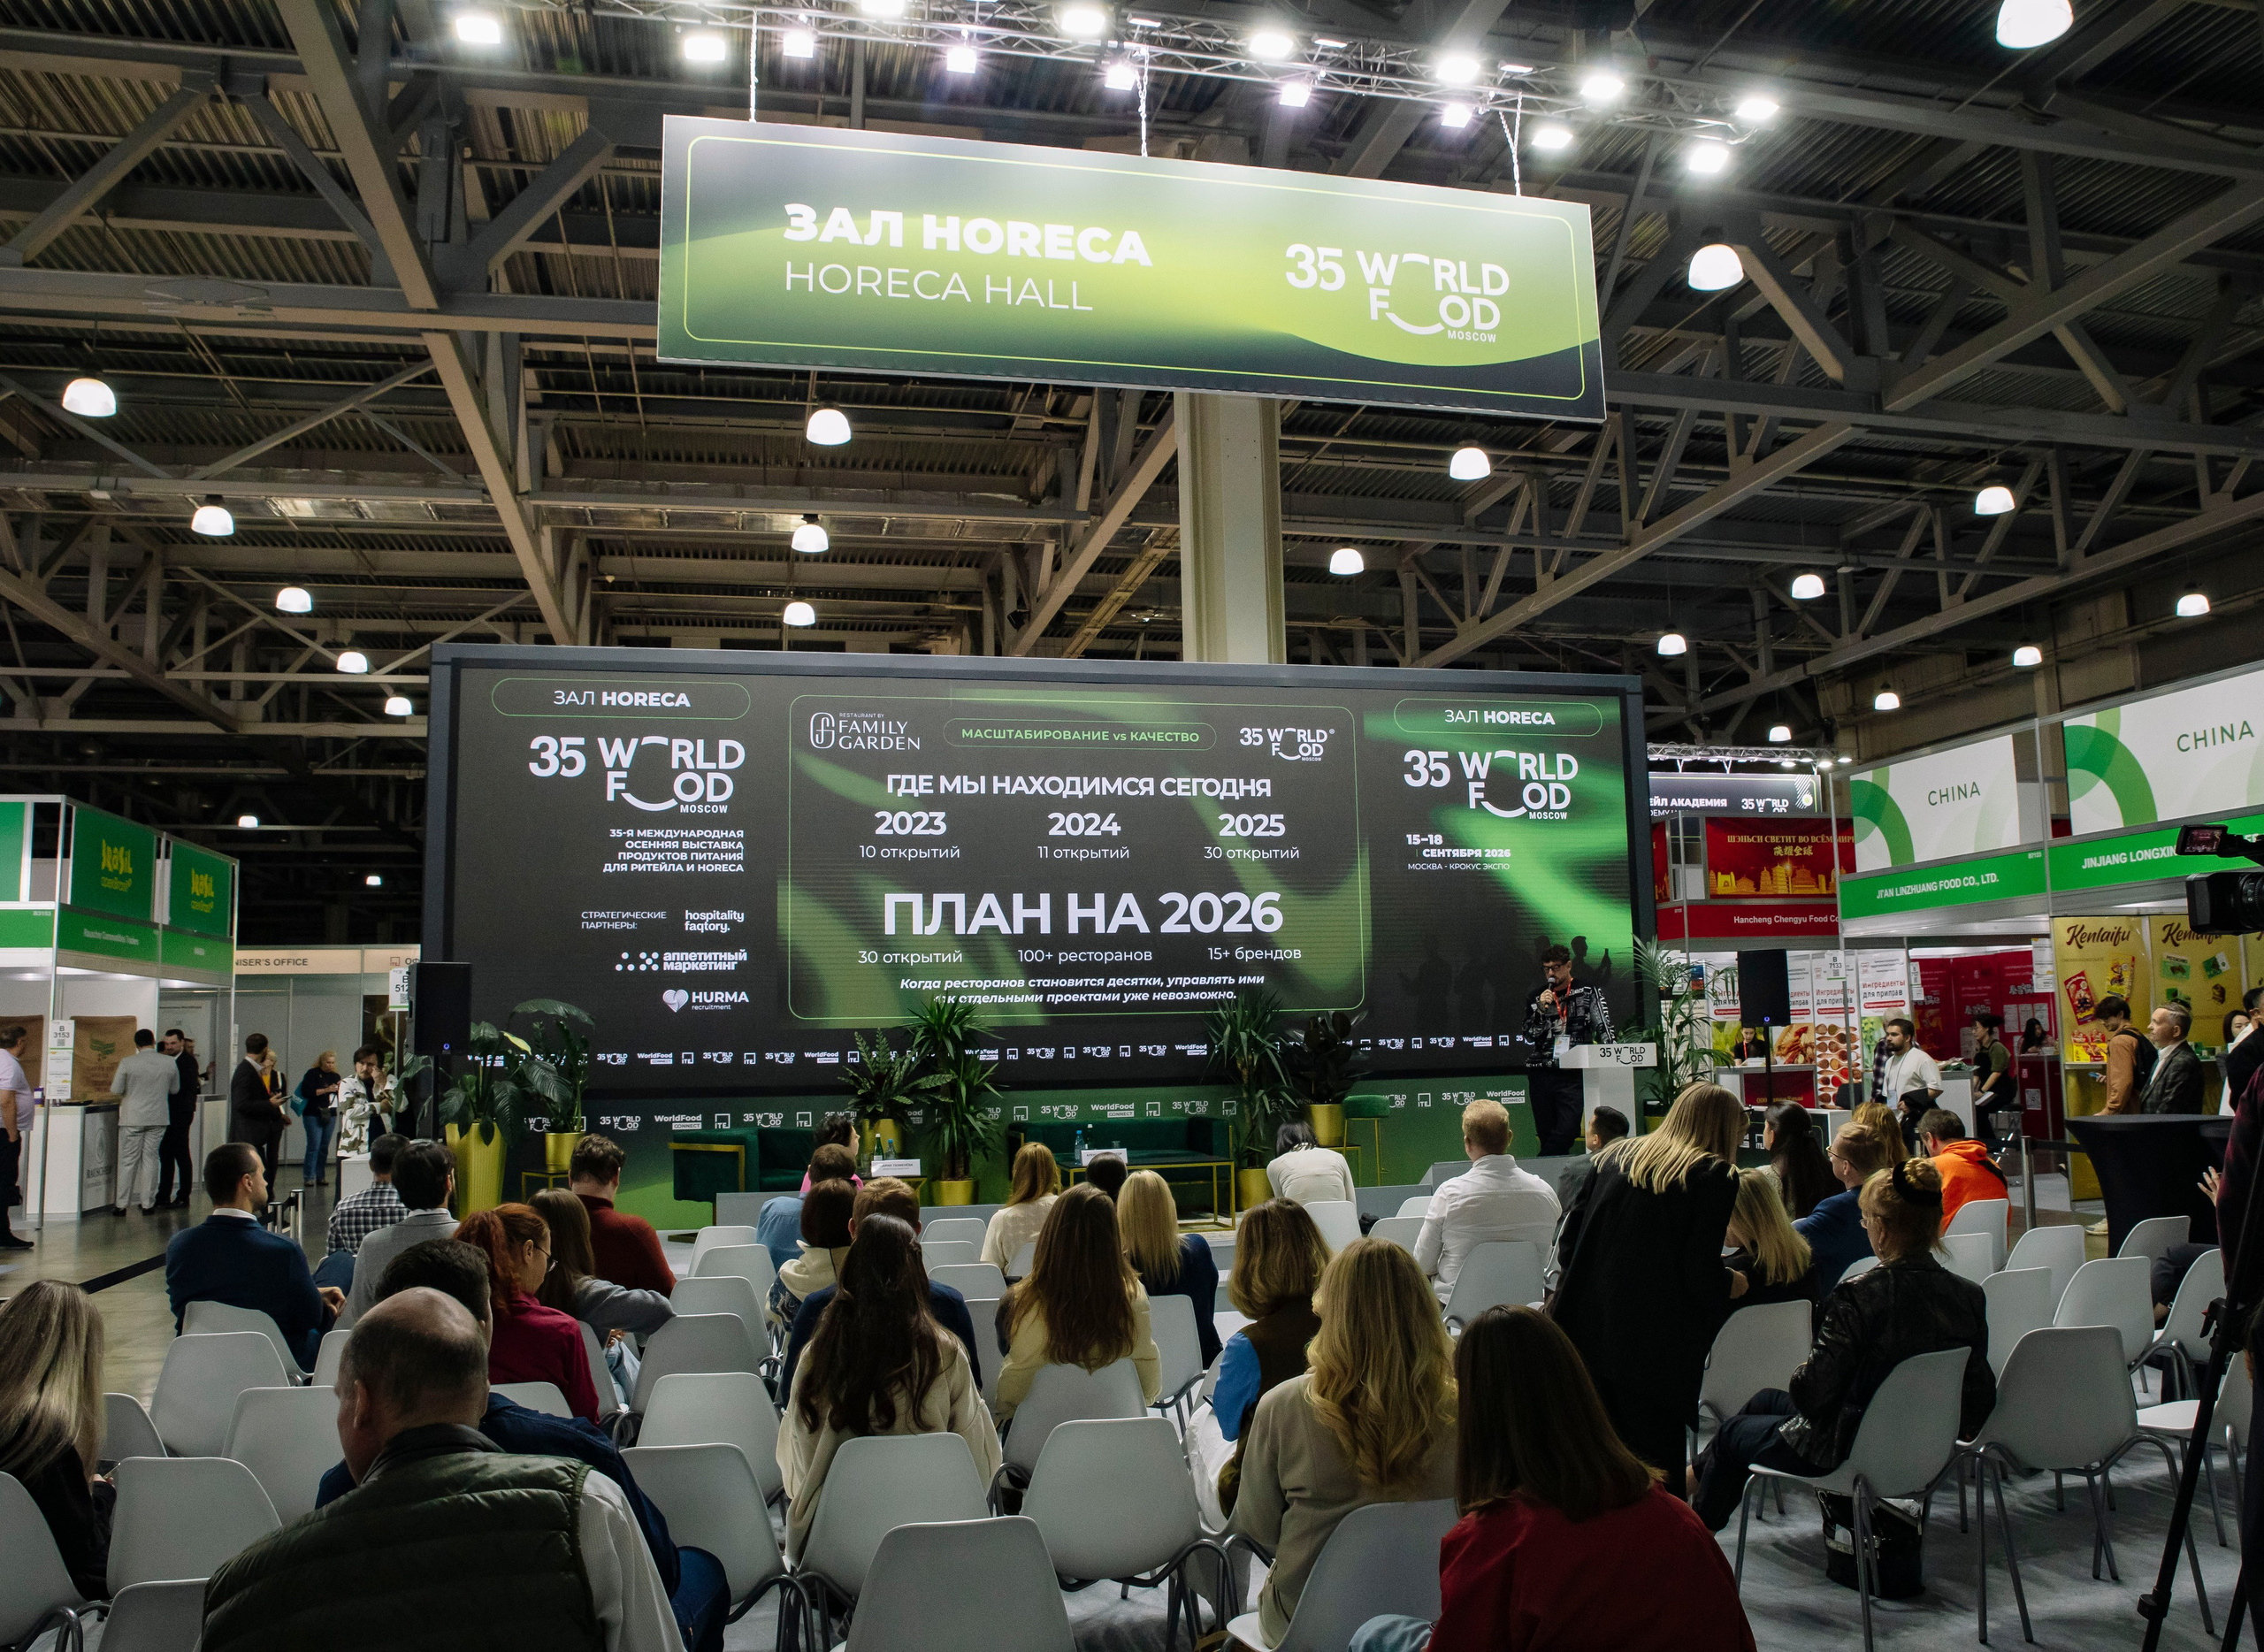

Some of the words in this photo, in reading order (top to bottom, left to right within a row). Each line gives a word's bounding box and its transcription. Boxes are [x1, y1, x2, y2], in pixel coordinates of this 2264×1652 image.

[783, 203, 903, 248] ЗАЛ
[922, 213, 1152, 266] HORECA
[1285, 243, 1346, 291] 35
[786, 261, 971, 302] HORECA
[985, 274, 1093, 310] HALL
[1447, 329, 1496, 343] MOSCOW
[553, 690, 595, 705] ЗАЛ
[601, 692, 691, 707] HORECA
[1444, 710, 1478, 723] ЗАЛ
[1484, 711, 1556, 725] HORECA
[839, 720, 908, 734] FAMILY
[961, 728, 1109, 741] МАСШТАБИРОВАНИЕ
[1130, 731, 1199, 742] КАЧЕСТВО
[1239, 727, 1263, 746] 35
[2177, 720, 2254, 753] CHINA
[839, 736, 920, 750] GARDEN
[529, 736, 585, 776] 35
[1404, 750, 1451, 787] 35
[887, 774, 933, 797] ГДЕ
[940, 775, 986, 794] МЫ
[993, 776, 1155, 799] НАХОДИМСЯ
[1160, 778, 1271, 799] СЕГОДНЯ
[1928, 781, 1981, 807] CHINA
[680, 804, 728, 814] MOSCOW
[1670, 798, 1728, 808] АКАДЕМИЯ
[1741, 798, 1755, 810] 35
[1529, 811, 1568, 820] MOSCOW
[874, 811, 947, 835] 2023
[1048, 812, 1121, 836] 2024
[1218, 813, 1286, 837] 2025
[609, 829, 634, 837] 35-Я
[637, 830, 744, 839] МЕЖДУНАРОДНАЯ
[625, 841, 679, 849] ОСЕННЯЯ
[682, 841, 744, 849] ВЫСТАВКА
[618, 852, 688, 861] ПРОДУКТОВ
[860, 845, 876, 858] 10
[880, 845, 960, 861] открытий
[1037, 845, 1048, 858] 11
[1053, 845, 1129, 861] открытий
[1204, 846, 1222, 859] 30
[1226, 846, 1299, 861] открытий
[1422, 849, 1482, 858] СЕНТЯБРЯ
[1484, 849, 1511, 858] 2026
[603, 863, 627, 873] ДЛЯ
[631, 862, 684, 872] РИТЕЙЛА
[686, 864, 695, 872] И
[697, 864, 744, 872] HORECA
[2082, 852, 2128, 869] JINJIANG
[1895, 882, 1938, 896] LINZHUANG
[1939, 879, 1962, 891] FOOD
[1981, 873, 1999, 884] LTD.
[685, 910, 744, 922] hospitality
[884, 893, 1051, 935] ПЛАН
[1067, 893, 1150, 934] НА
[1158, 891, 1283, 933] 2026
[1734, 916, 1772, 925] Hancheng
[1774, 915, 1807, 924] Chengyu
[685, 921, 730, 933] faqtory.
[663, 949, 747, 961] аппетитный
[858, 950, 878, 964] 30
[883, 950, 963, 965] открытий
[1017, 949, 1053, 962] 100+
[1059, 950, 1152, 964] ресторанов
[1208, 948, 1230, 960] 15+
[1235, 947, 1301, 962] брендов
[663, 961, 738, 973] маркетинг
[900, 979, 941, 990] Когда
[944, 979, 1025, 990] ресторанов
[1028, 977, 1104, 987] становится
[1107, 976, 1164, 988] десятки,
[1166, 976, 1235, 988] управлять
[1238, 975, 1265, 985] ими
[1862, 980, 1905, 989] Ингредиенты
[692, 991, 749, 1003] HURMA
[959, 993, 1043, 1005] отдельными
[1047, 992, 1121, 1003] проектами
[1123, 991, 1150, 1003] уже
[1152, 990, 1237, 1001] невозможно.
[1599, 1048, 1612, 1058] 35
[1040, 1106, 1052, 1114] 35
[1172, 1101, 1182, 1109] 35
[600, 1117, 611, 1125] 35
[743, 1113, 754, 1122] 35
